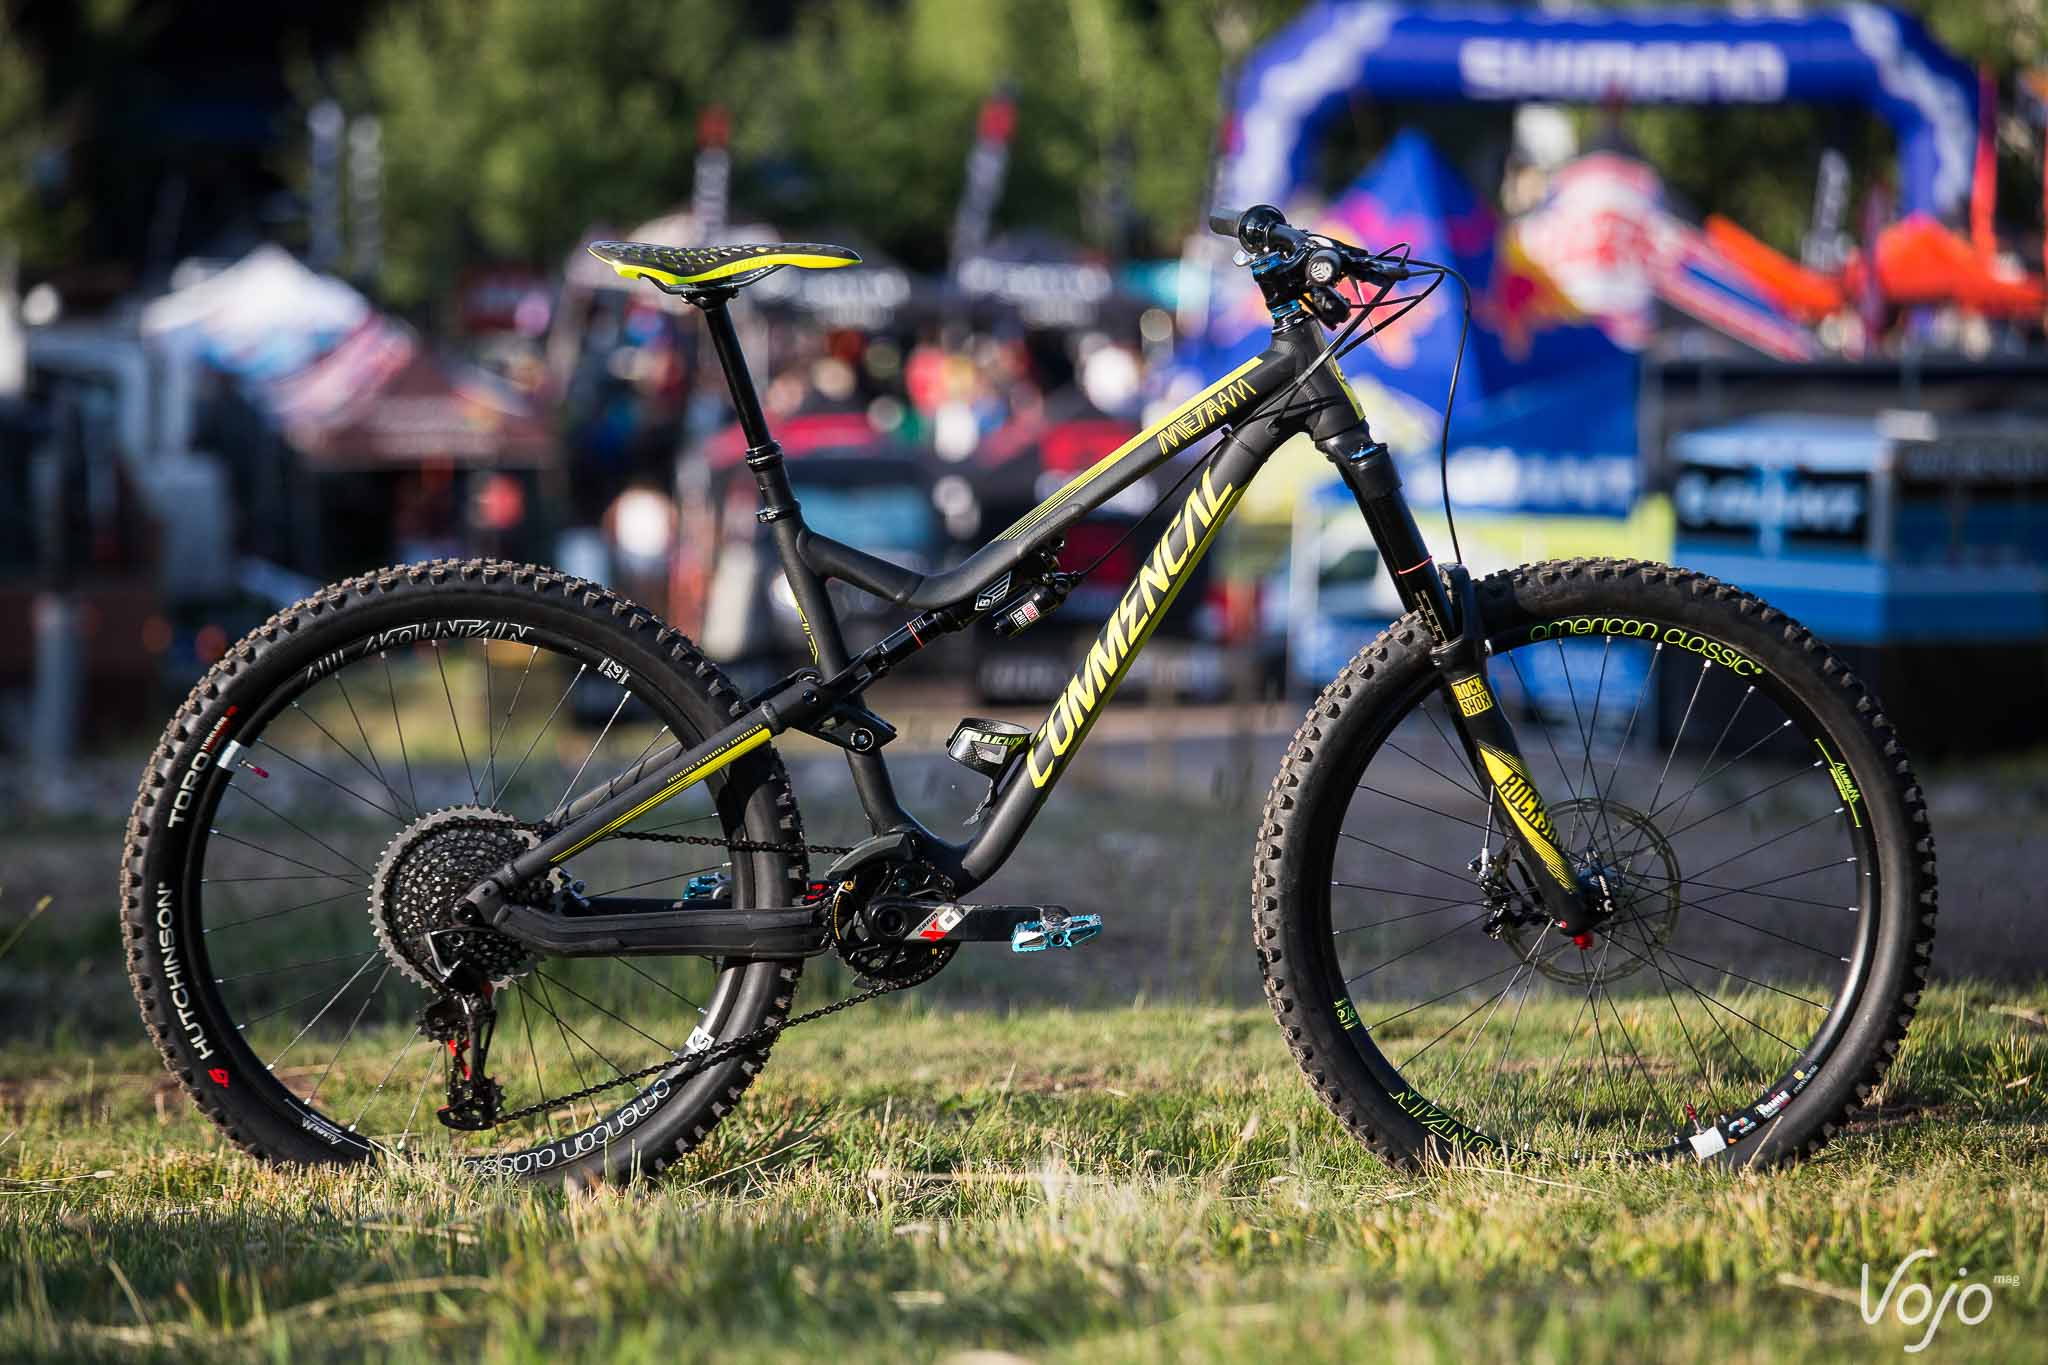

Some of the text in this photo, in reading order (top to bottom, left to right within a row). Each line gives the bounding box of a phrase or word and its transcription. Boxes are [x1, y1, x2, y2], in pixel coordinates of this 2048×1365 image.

[363, 618, 537, 655] MOUNTAIN
[1027, 467, 1233, 788] COMMENCAL
[1530, 617, 1660, 642] american
[1454, 676, 1484, 700] ROCK
[1461, 690, 1492, 716] SHOX
[167, 751, 212, 828] TORO
[1499, 771, 1564, 848] ROCKSH
[917, 912, 939, 933] SRAM
[156, 888, 215, 1061] HUTCHINSON
